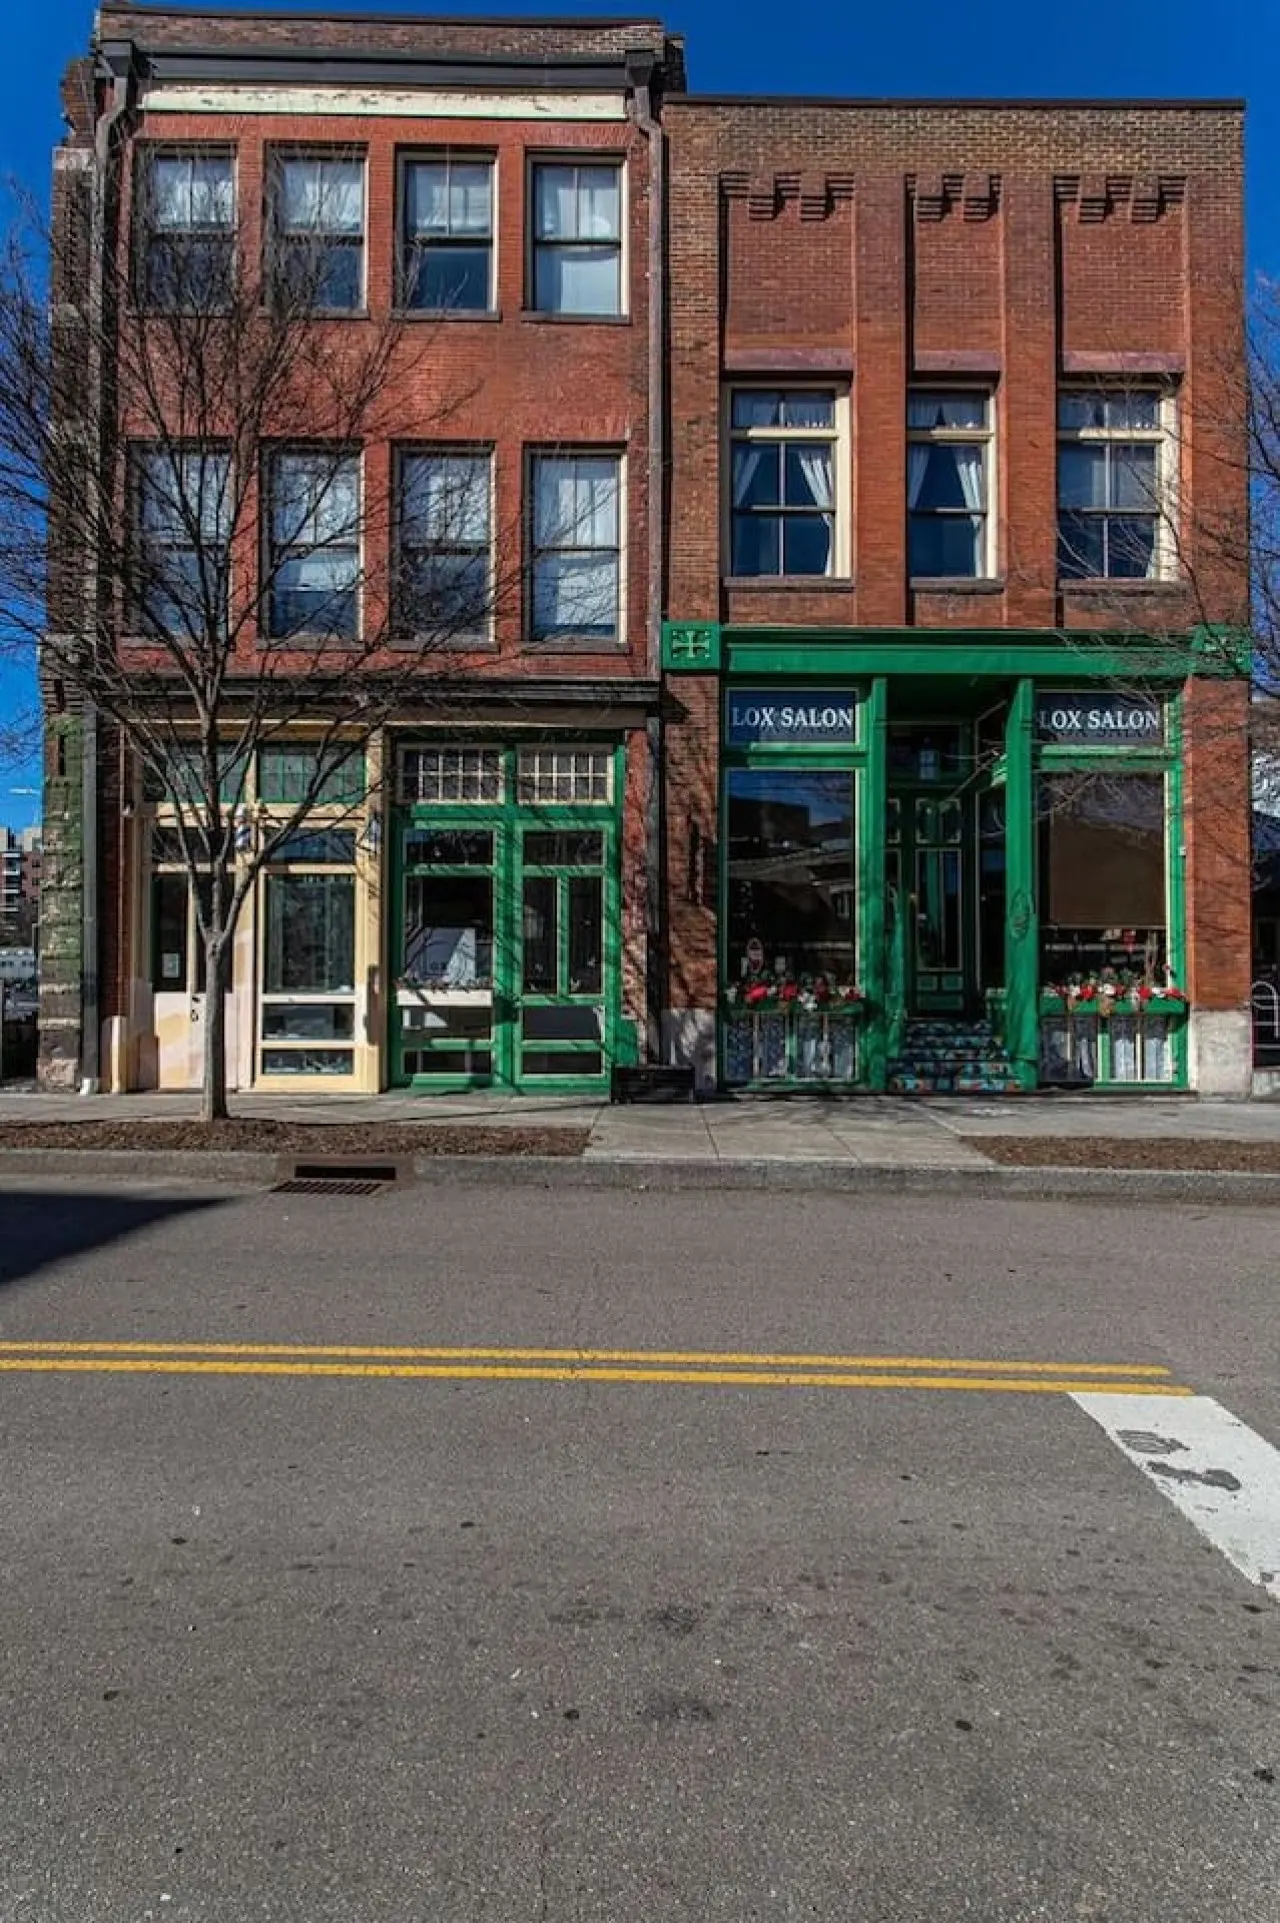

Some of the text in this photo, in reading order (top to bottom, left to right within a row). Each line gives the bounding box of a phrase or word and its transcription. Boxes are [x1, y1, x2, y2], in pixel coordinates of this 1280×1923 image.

[732, 706, 853, 728] LOX SALON
[1040, 710, 1160, 730] LOX SALON
